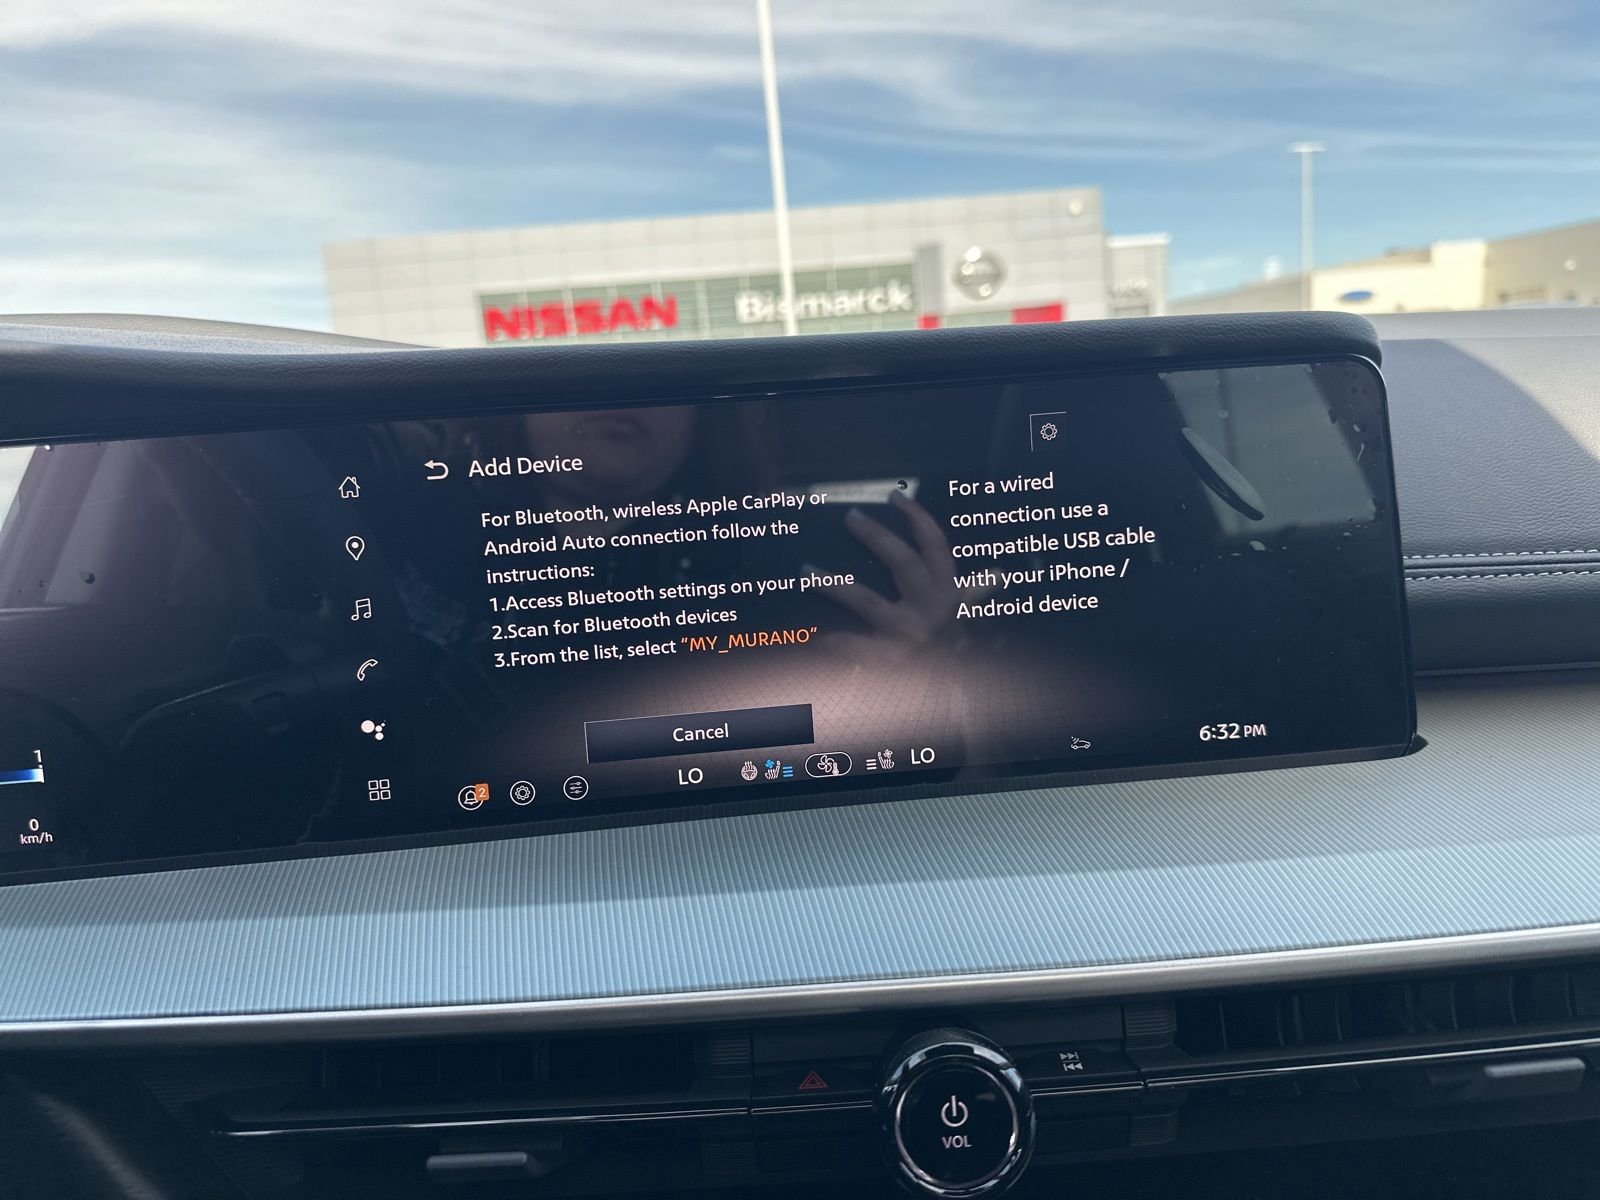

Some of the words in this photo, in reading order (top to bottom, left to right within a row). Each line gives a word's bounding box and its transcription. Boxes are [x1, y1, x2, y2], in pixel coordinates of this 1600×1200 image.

[485, 296, 678, 341] NISSAN
[468, 457, 512, 478] Add
[517, 455, 583, 474] Device
[948, 480, 979, 496] For
[984, 482, 995, 494] a
[1000, 471, 1054, 492] wired
[481, 512, 511, 527] For
[515, 505, 609, 526] Bluetooth,
[612, 501, 682, 520] wireless
[686, 496, 737, 517] Apple
[742, 492, 805, 511] CarPlay
[809, 491, 827, 505] or
[950, 505, 1055, 527] connection
[1061, 504, 1093, 518] use
[1097, 504, 1109, 516] a
[484, 536, 557, 556] Android
[562, 535, 606, 551] Auto
[610, 528, 707, 547] connection
[711, 525, 767, 540] follow
[770, 520, 799, 535] the
[952, 535, 1059, 559] compatible
[1063, 532, 1101, 549] USB
[1105, 526, 1156, 546] cable
[486, 565, 595, 584] instructions:
[953, 568, 997, 588] with
[1001, 567, 1045, 589] your
[1049, 562, 1116, 581] iPhone
[1120, 558, 1130, 578] /
[490, 596, 563, 612] 1.Access
[567, 587, 655, 605] Bluetooth
[658, 582, 727, 601] settings
[730, 580, 754, 594] on
[757, 576, 796, 595] your
[800, 573, 855, 592] phone
[956, 596, 1033, 619] Android
[1038, 593, 1099, 612] device
[491, 623, 549, 640] 2.Scan
[553, 618, 580, 634] for
[584, 613, 671, 632] Bluetooth
[675, 608, 738, 624] devices
[494, 651, 555, 668] 3.From
[559, 647, 590, 663] the
[593, 644, 623, 660] list,
[626, 640, 677, 656] select
[672, 723, 730, 742] Cancel
[1199, 723, 1240, 741] 6:32
[1243, 724, 1266, 738] PM
[33, 749, 42, 763] 1
[910, 747, 936, 765] LO
[677, 767, 704, 786] LO
[478, 787, 486, 798] 2
[29, 818, 40, 831] 0
[20, 832, 53, 844] km/h
[942, 1135, 972, 1149] VOL
